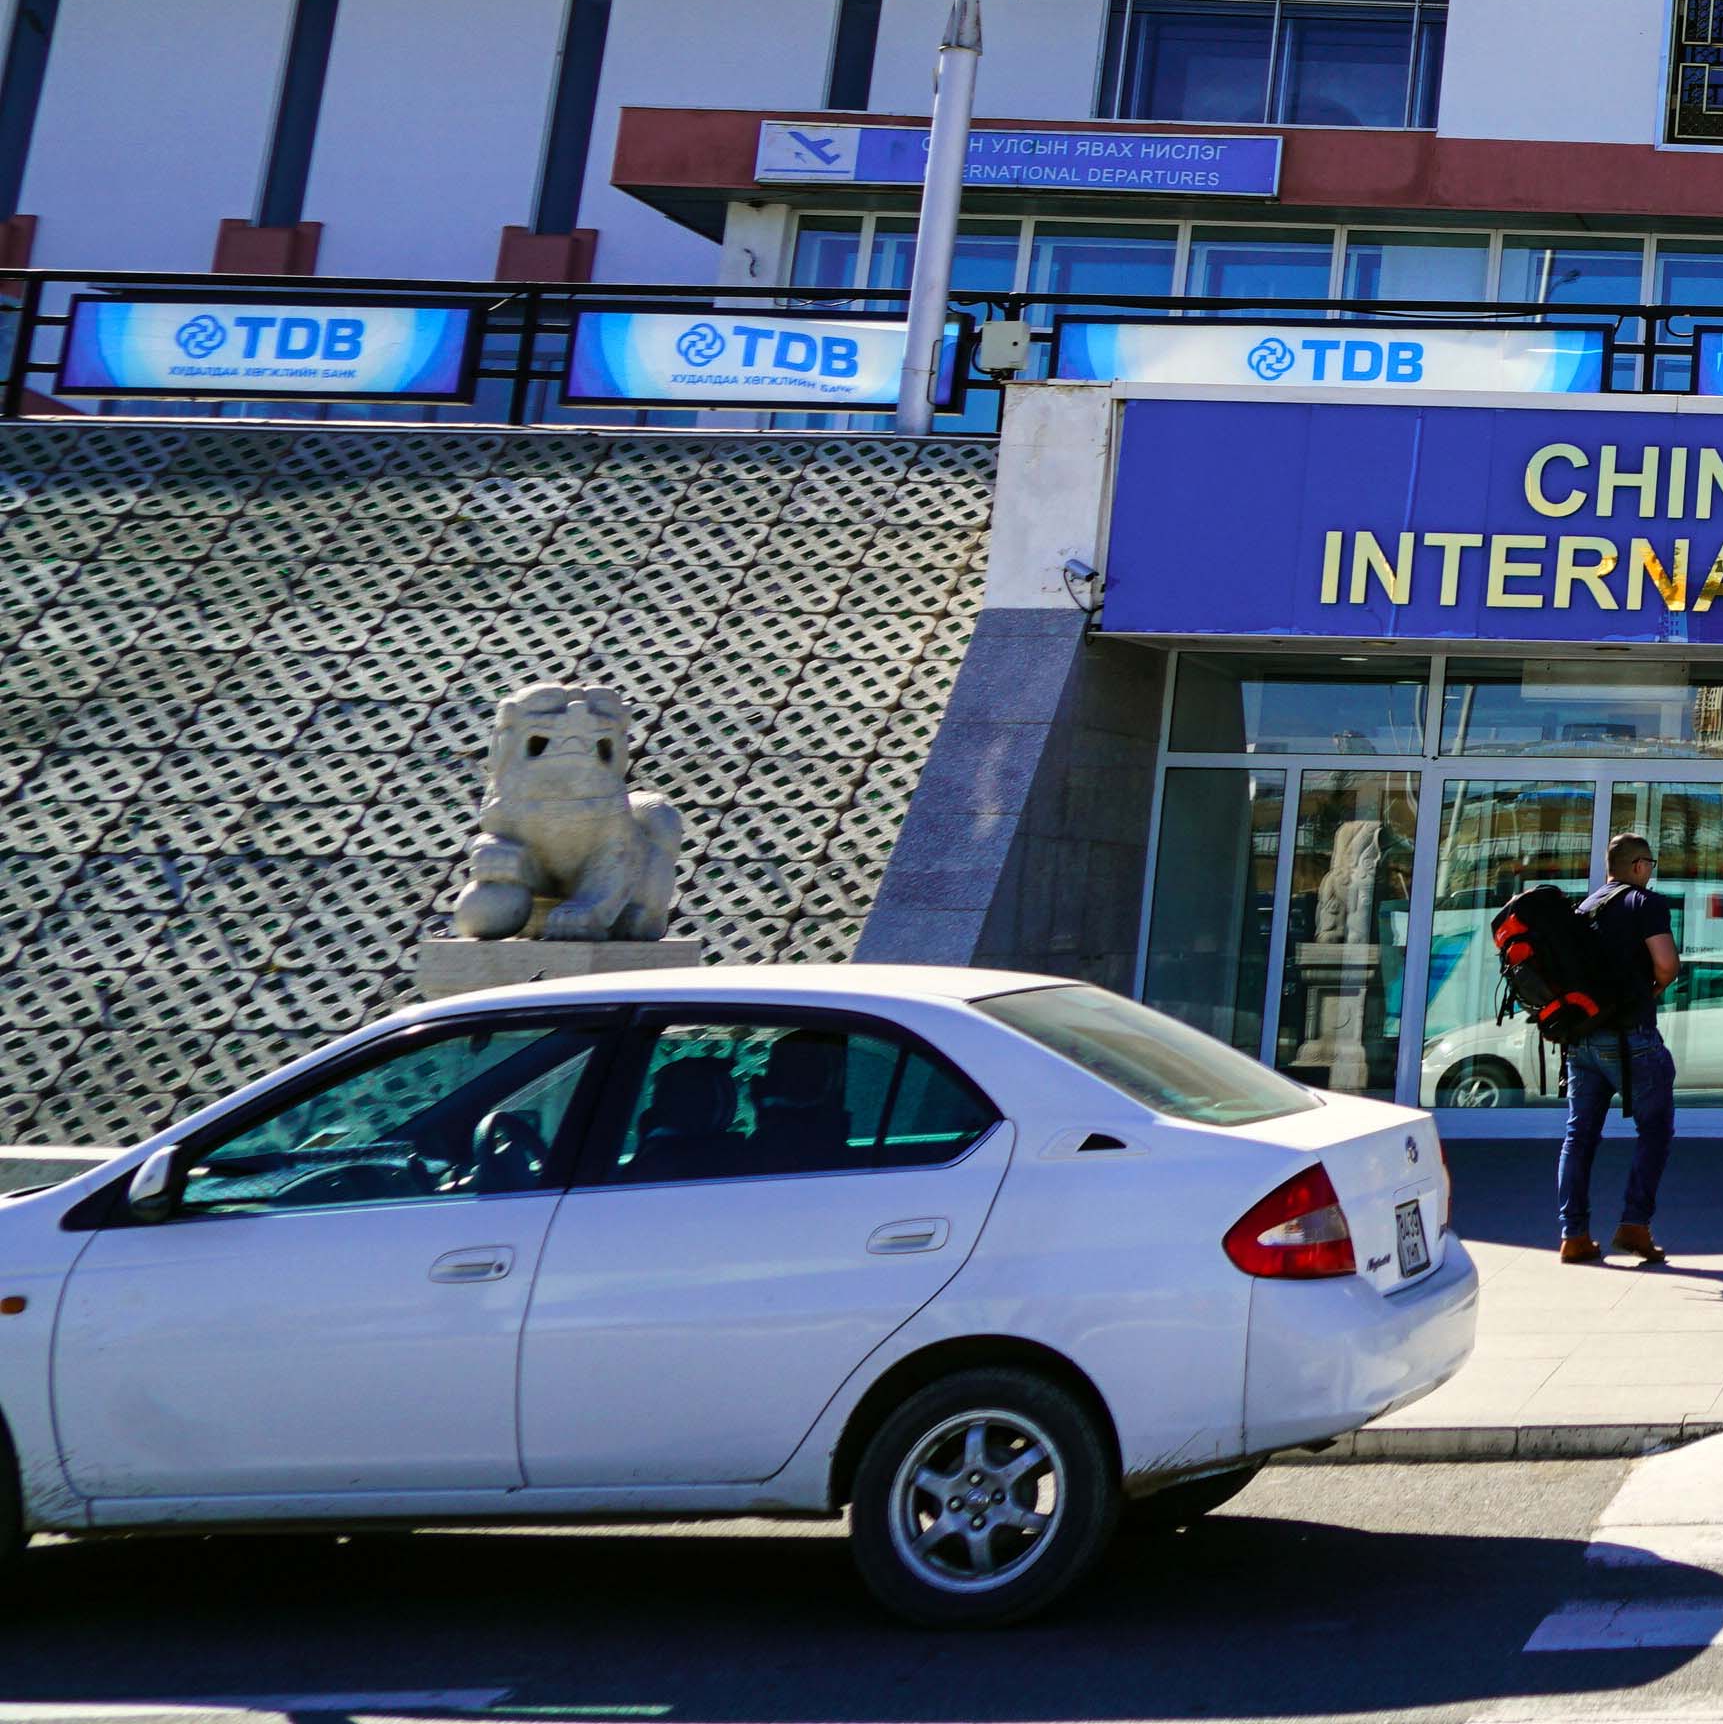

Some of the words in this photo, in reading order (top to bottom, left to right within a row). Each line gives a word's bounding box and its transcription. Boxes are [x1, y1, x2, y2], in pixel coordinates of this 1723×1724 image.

[921, 136, 983, 152] ОН
[992, 138, 1068, 156] УЛСЫН
[1075, 142, 1133, 158] ЯВАХ
[1140, 144, 1228, 161] НИСЛЭГ
[1088, 167, 1220, 186] DEPARTURES
[235, 316, 366, 361] TDB
[733, 325, 859, 378] TDB
[1302, 340, 1424, 383] TDB
